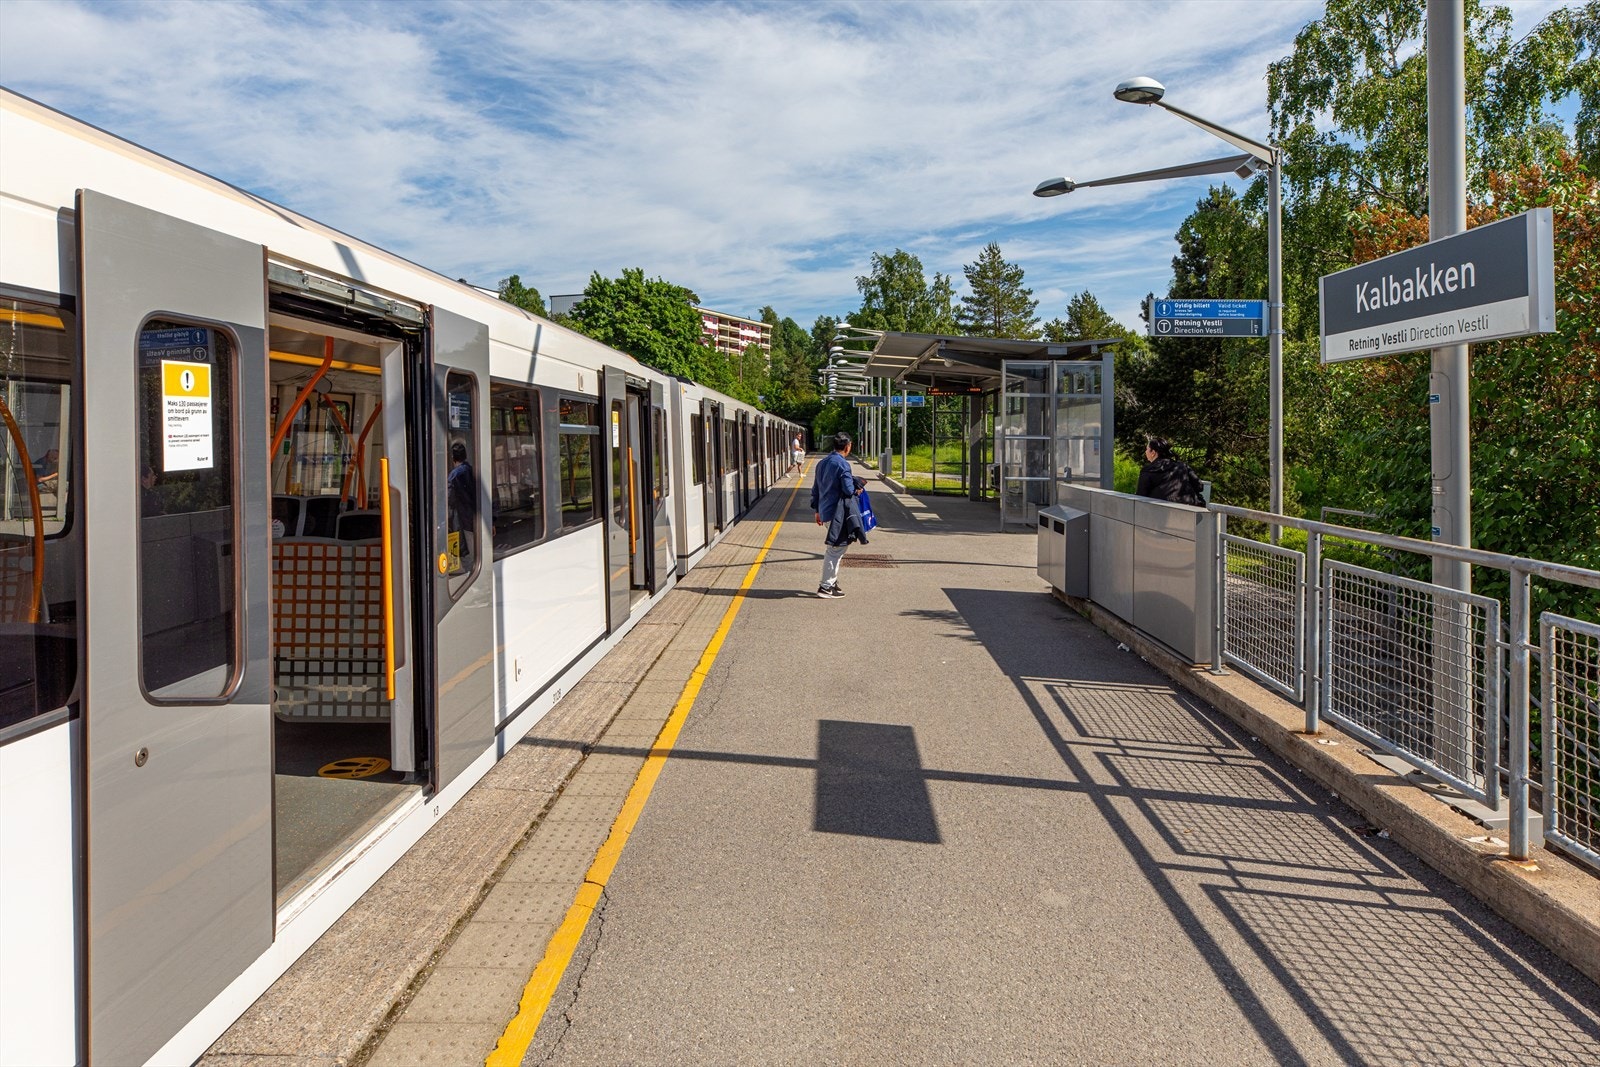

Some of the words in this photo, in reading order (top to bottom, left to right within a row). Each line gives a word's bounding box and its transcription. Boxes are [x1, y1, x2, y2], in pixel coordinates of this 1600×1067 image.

[1356, 261, 1476, 314] Kalbakken
[1349, 336, 1380, 351] Retning
[1381, 329, 1408, 346] Vestli
[1410, 322, 1455, 342] Direction
[1457, 314, 1489, 334] Vestli
[433, 805, 439, 818] 13
